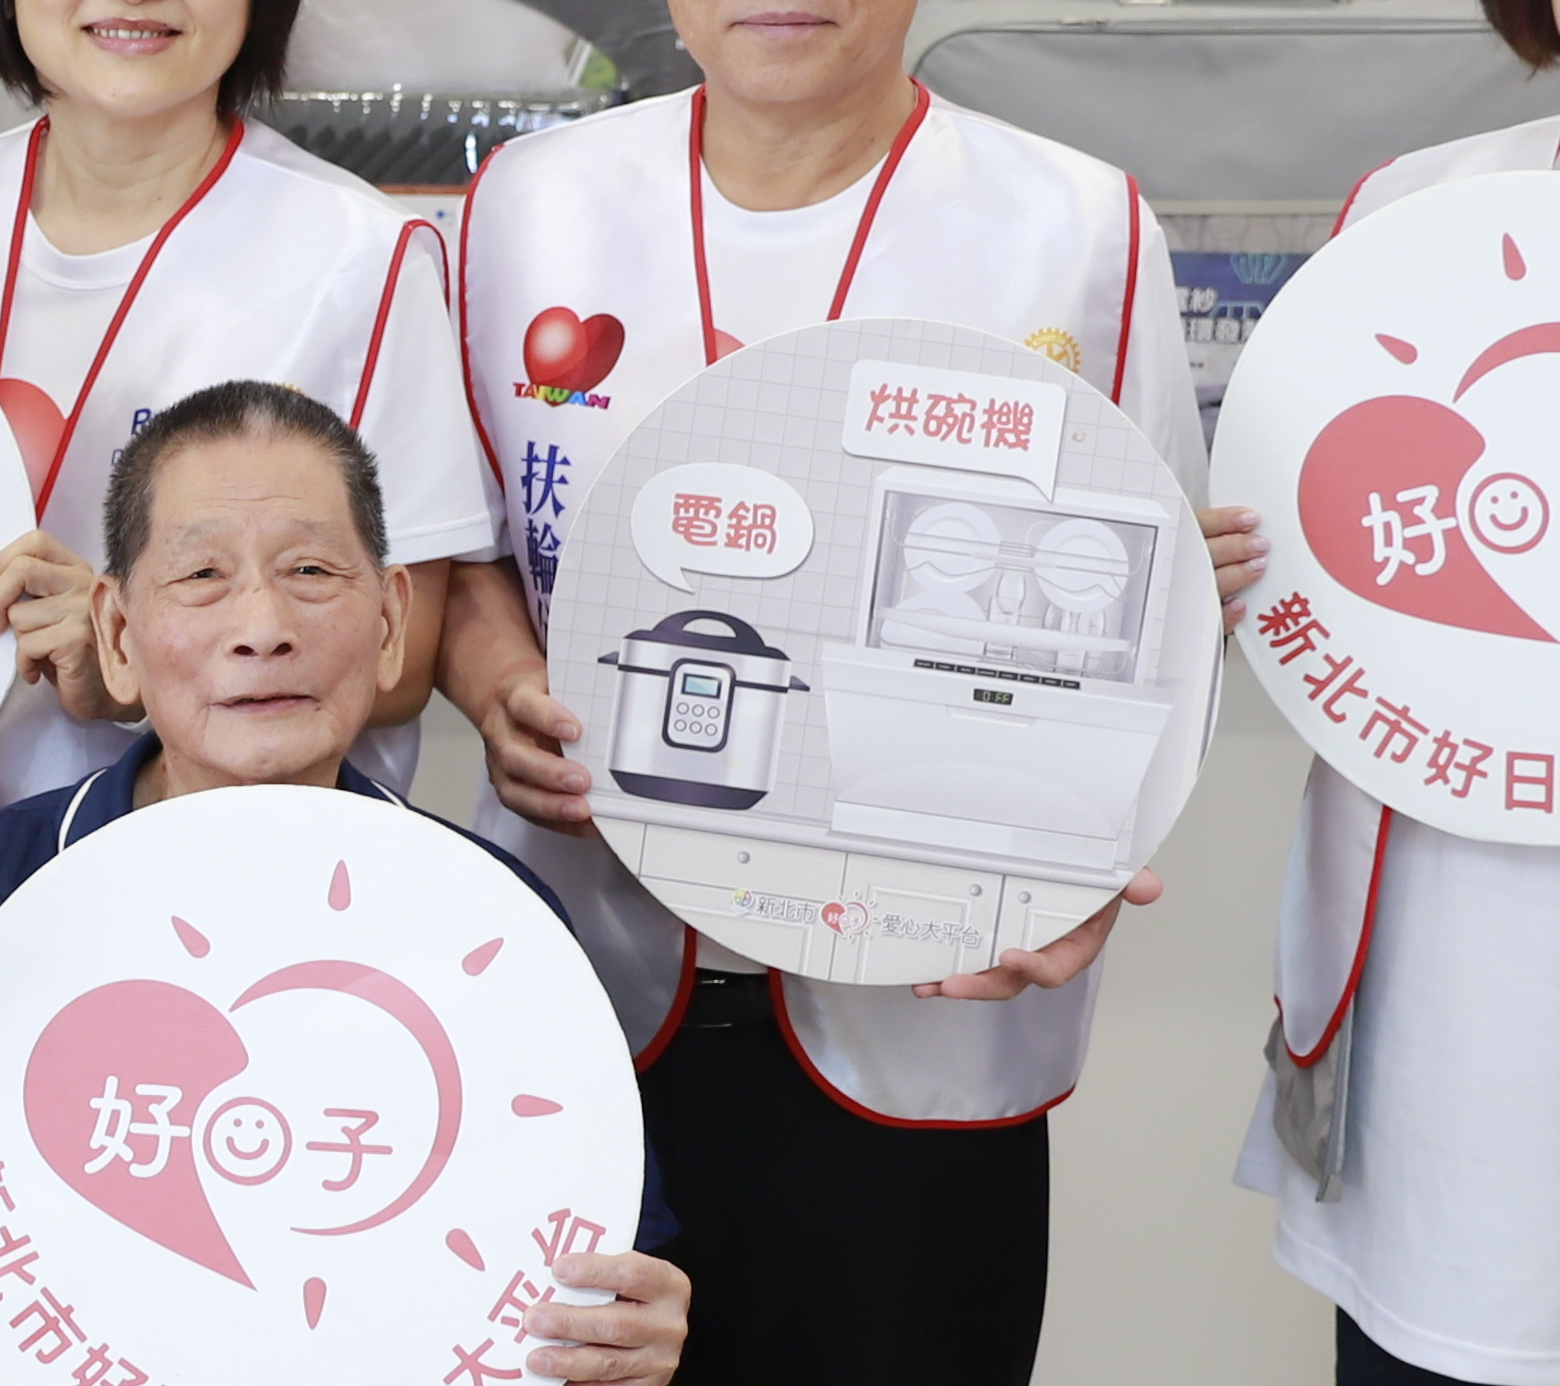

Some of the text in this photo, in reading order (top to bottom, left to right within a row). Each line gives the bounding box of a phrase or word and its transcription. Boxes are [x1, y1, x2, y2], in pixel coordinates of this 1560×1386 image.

[513, 382, 611, 410] TAIWAN
[865, 383, 1035, 451] 烘碗機
[521, 440, 572, 648] 扶輪
[669, 491, 779, 557] 電鍋
[757, 895, 816, 922] 新北市
[882, 913, 981, 946] 愛心大平台
